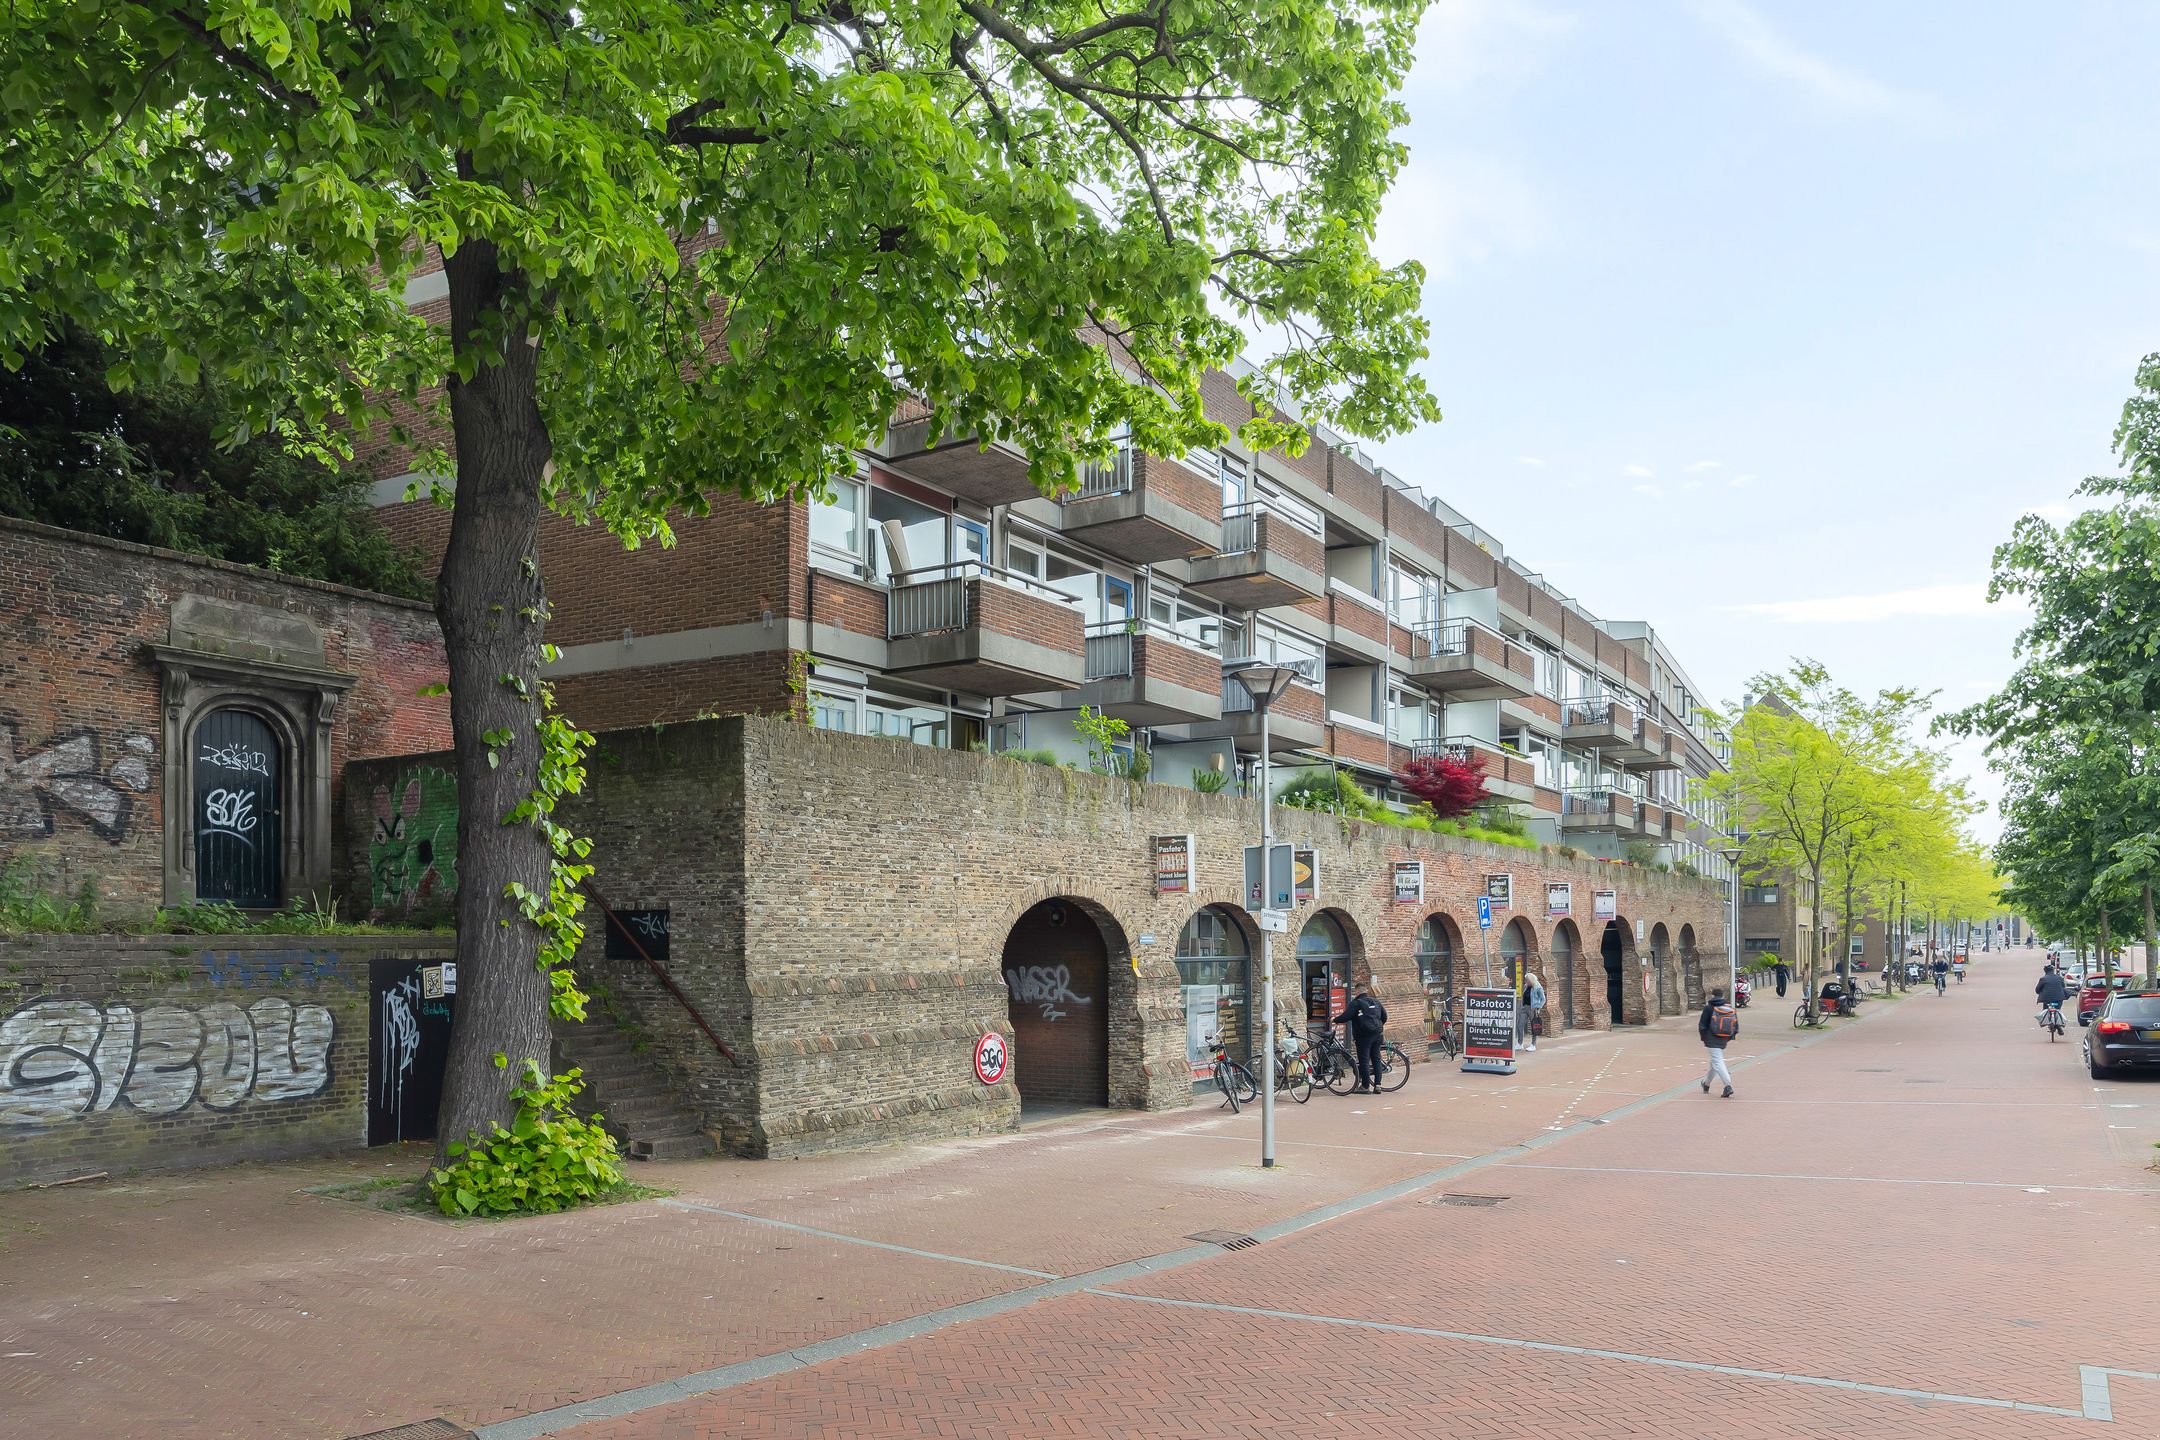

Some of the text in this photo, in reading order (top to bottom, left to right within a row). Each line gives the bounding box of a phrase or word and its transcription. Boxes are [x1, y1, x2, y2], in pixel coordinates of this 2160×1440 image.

[1158, 845, 1186, 853] Pasfoto's
[1481, 899, 1488, 916] P
[1470, 998, 1512, 1009] Pasfoto's
[1469, 1027, 1511, 1036] Direct klaar
